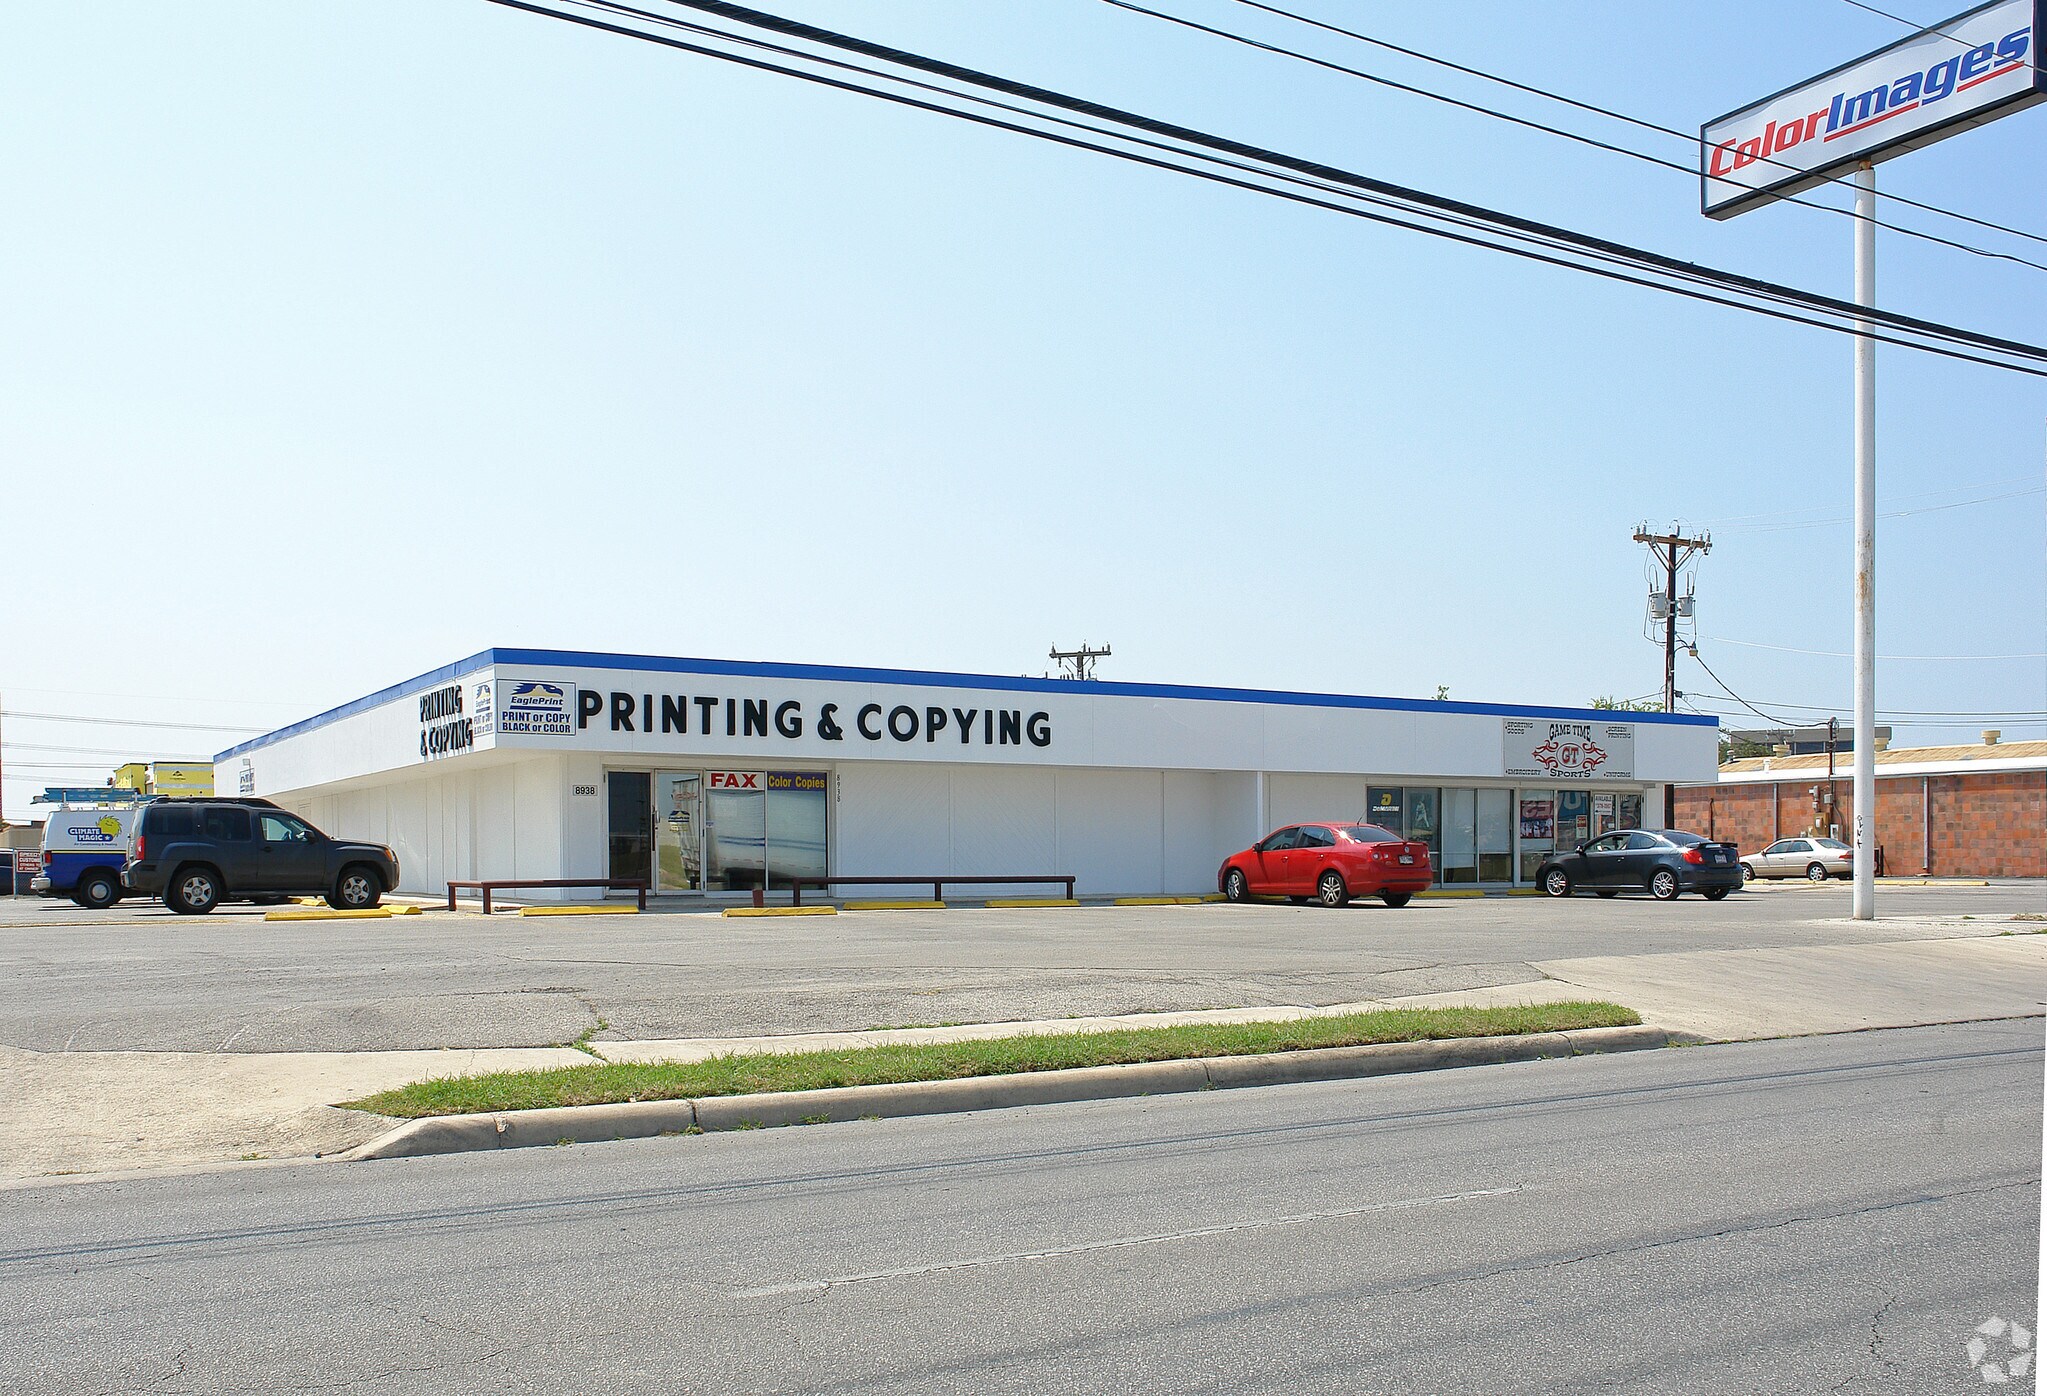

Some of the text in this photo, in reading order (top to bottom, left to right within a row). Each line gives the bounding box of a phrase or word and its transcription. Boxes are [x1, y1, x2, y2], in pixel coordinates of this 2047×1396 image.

[1709, 26, 2031, 177] ColorImages
[420, 685, 463, 722] PRINTING
[510, 696, 564, 706] EaglePrint
[502, 711, 571, 723] PRINT or COPY
[577, 689, 1052, 748] PRINTING & COPYING
[502, 722, 571, 733] BLACK or COLOR
[1549, 723, 1592, 742] GAME TIME
[420, 717, 473, 756] & COPYING
[1561, 746, 1580, 765] GT
[711, 773, 758, 788] FAX
[1550, 768, 1591, 778] SPORTS
[768, 775, 825, 790] Color Copies
[575, 786, 595, 795] 8938
